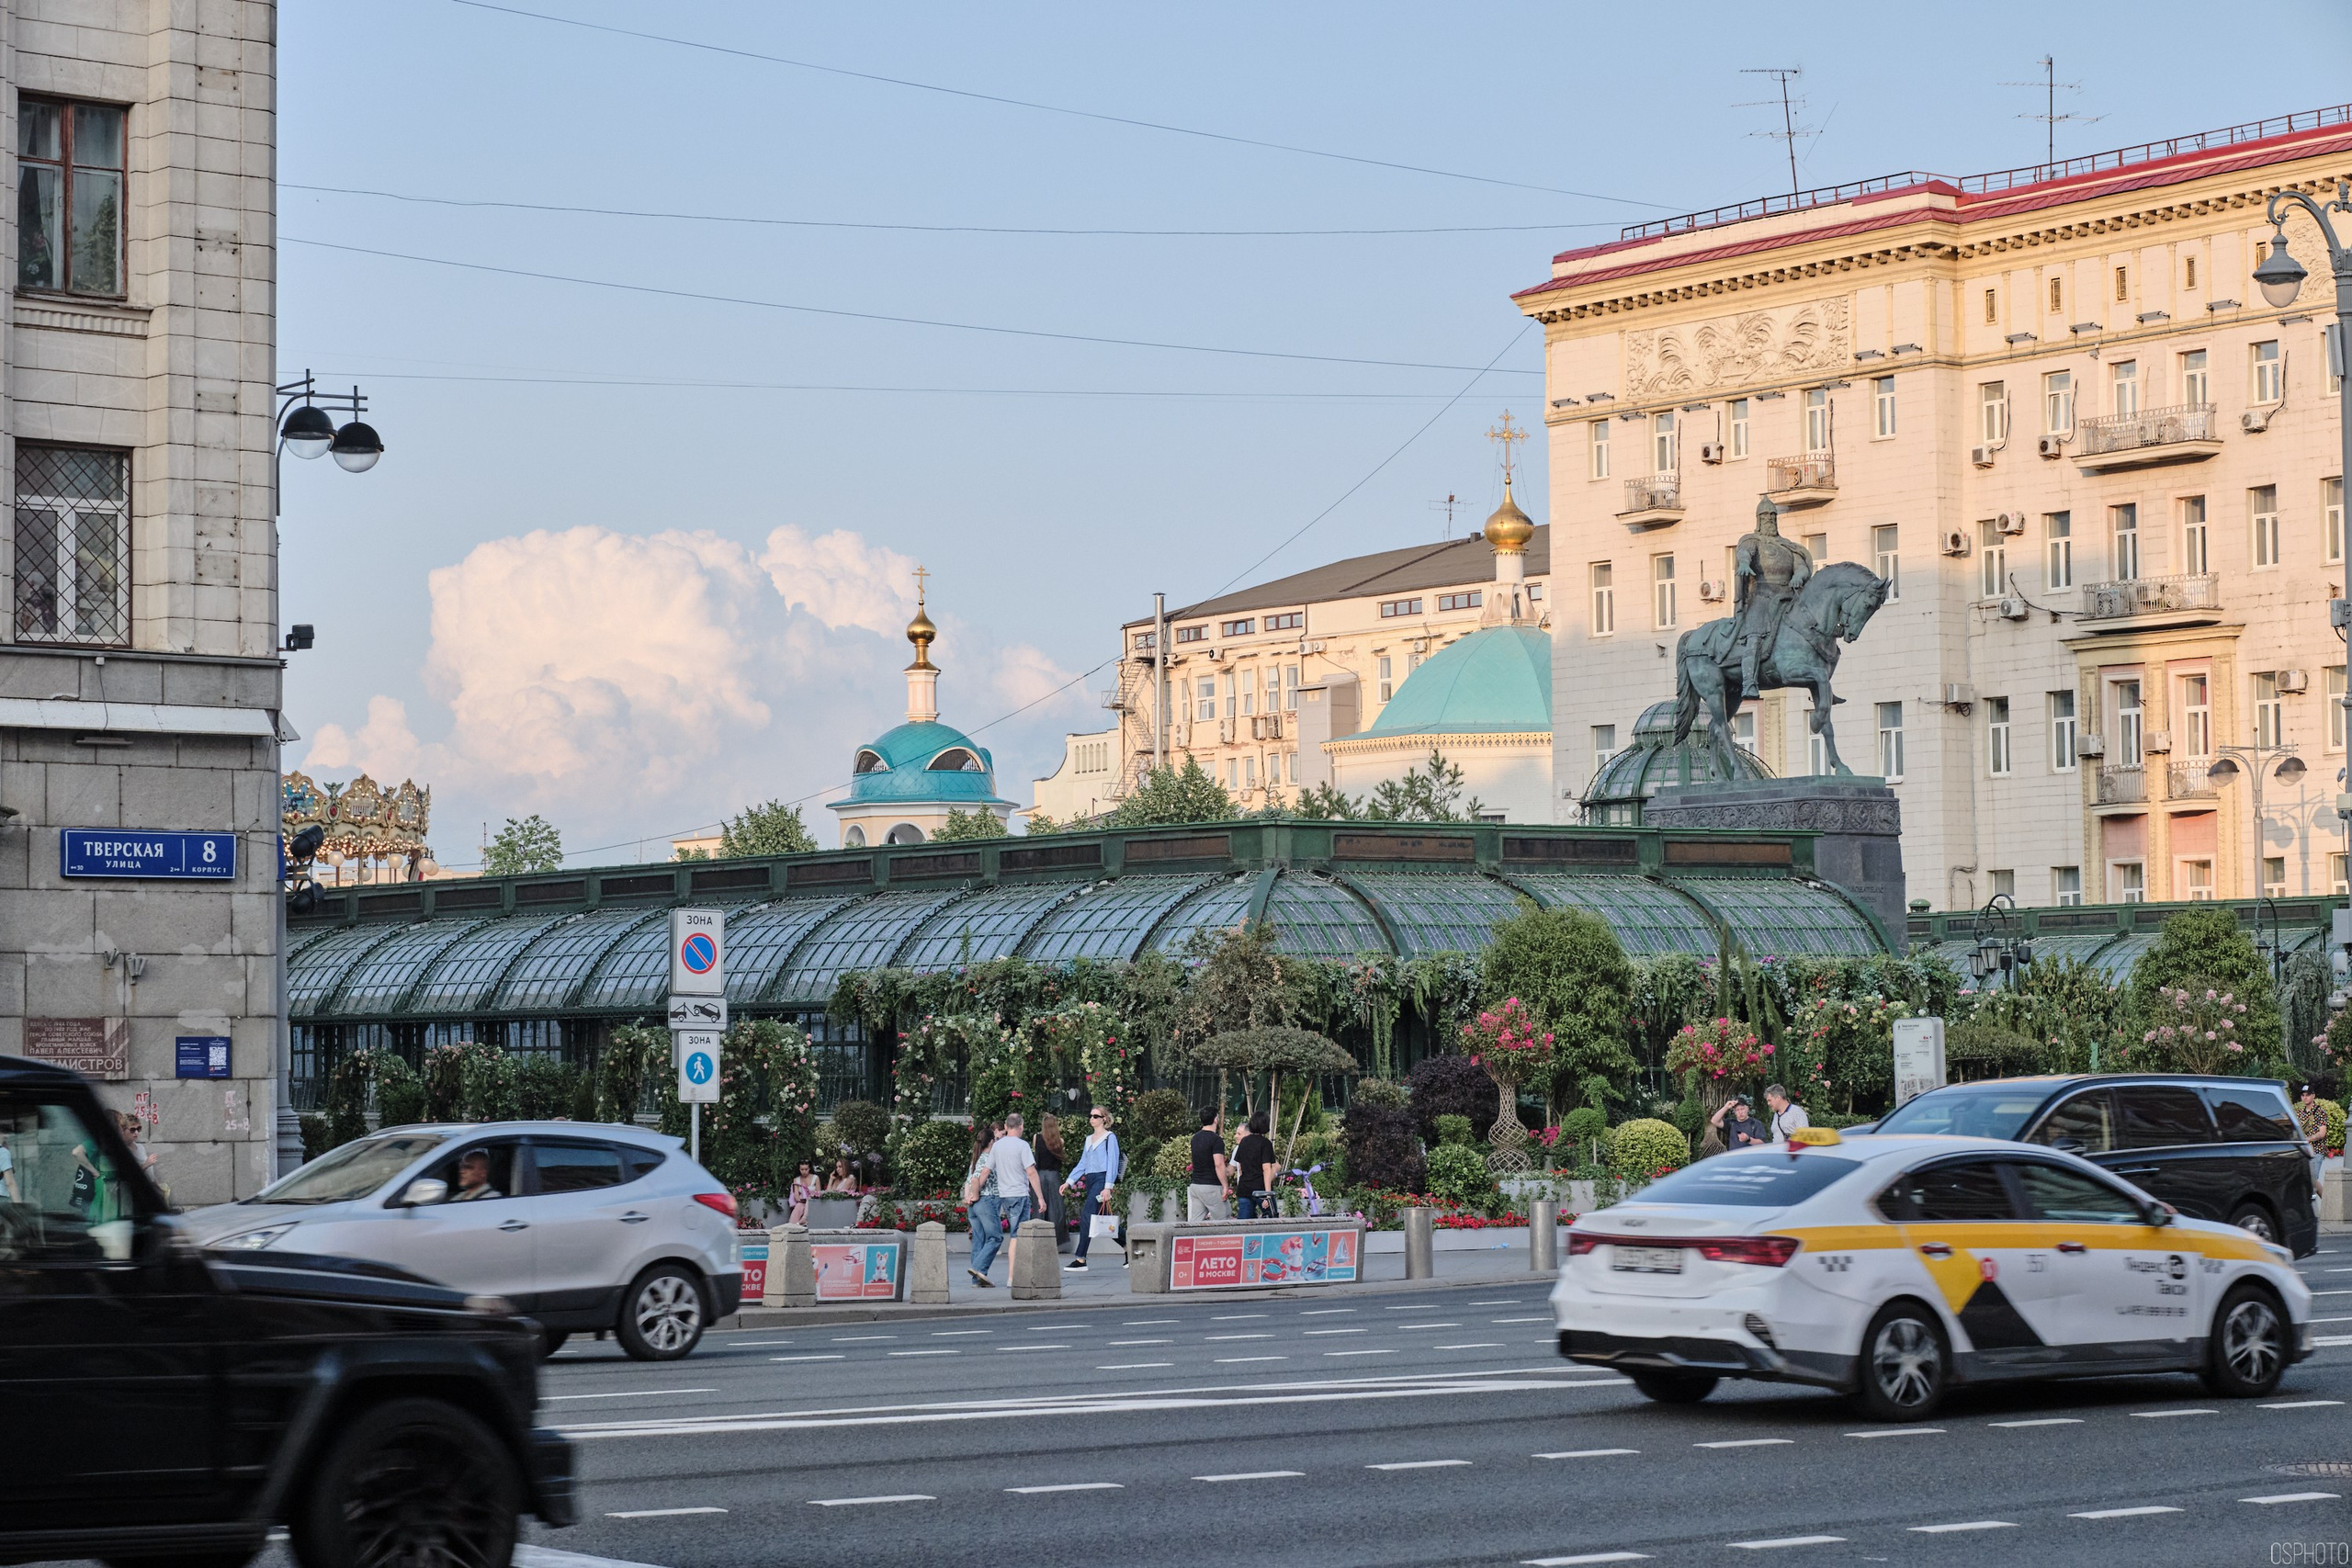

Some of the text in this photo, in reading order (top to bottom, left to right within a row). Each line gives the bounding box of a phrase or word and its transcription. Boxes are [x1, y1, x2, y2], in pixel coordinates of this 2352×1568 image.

[84, 841, 164, 857] ТВЕРСКАЯ
[202, 840, 217, 863] 8
[106, 860, 141, 869] УЛИЦА
[686, 915, 713, 925] ЗОНА
[688, 1036, 711, 1044] ЗОНА
[1200, 1257, 1237, 1269] ЛЕТО
[742, 1269, 763, 1281] ТО
